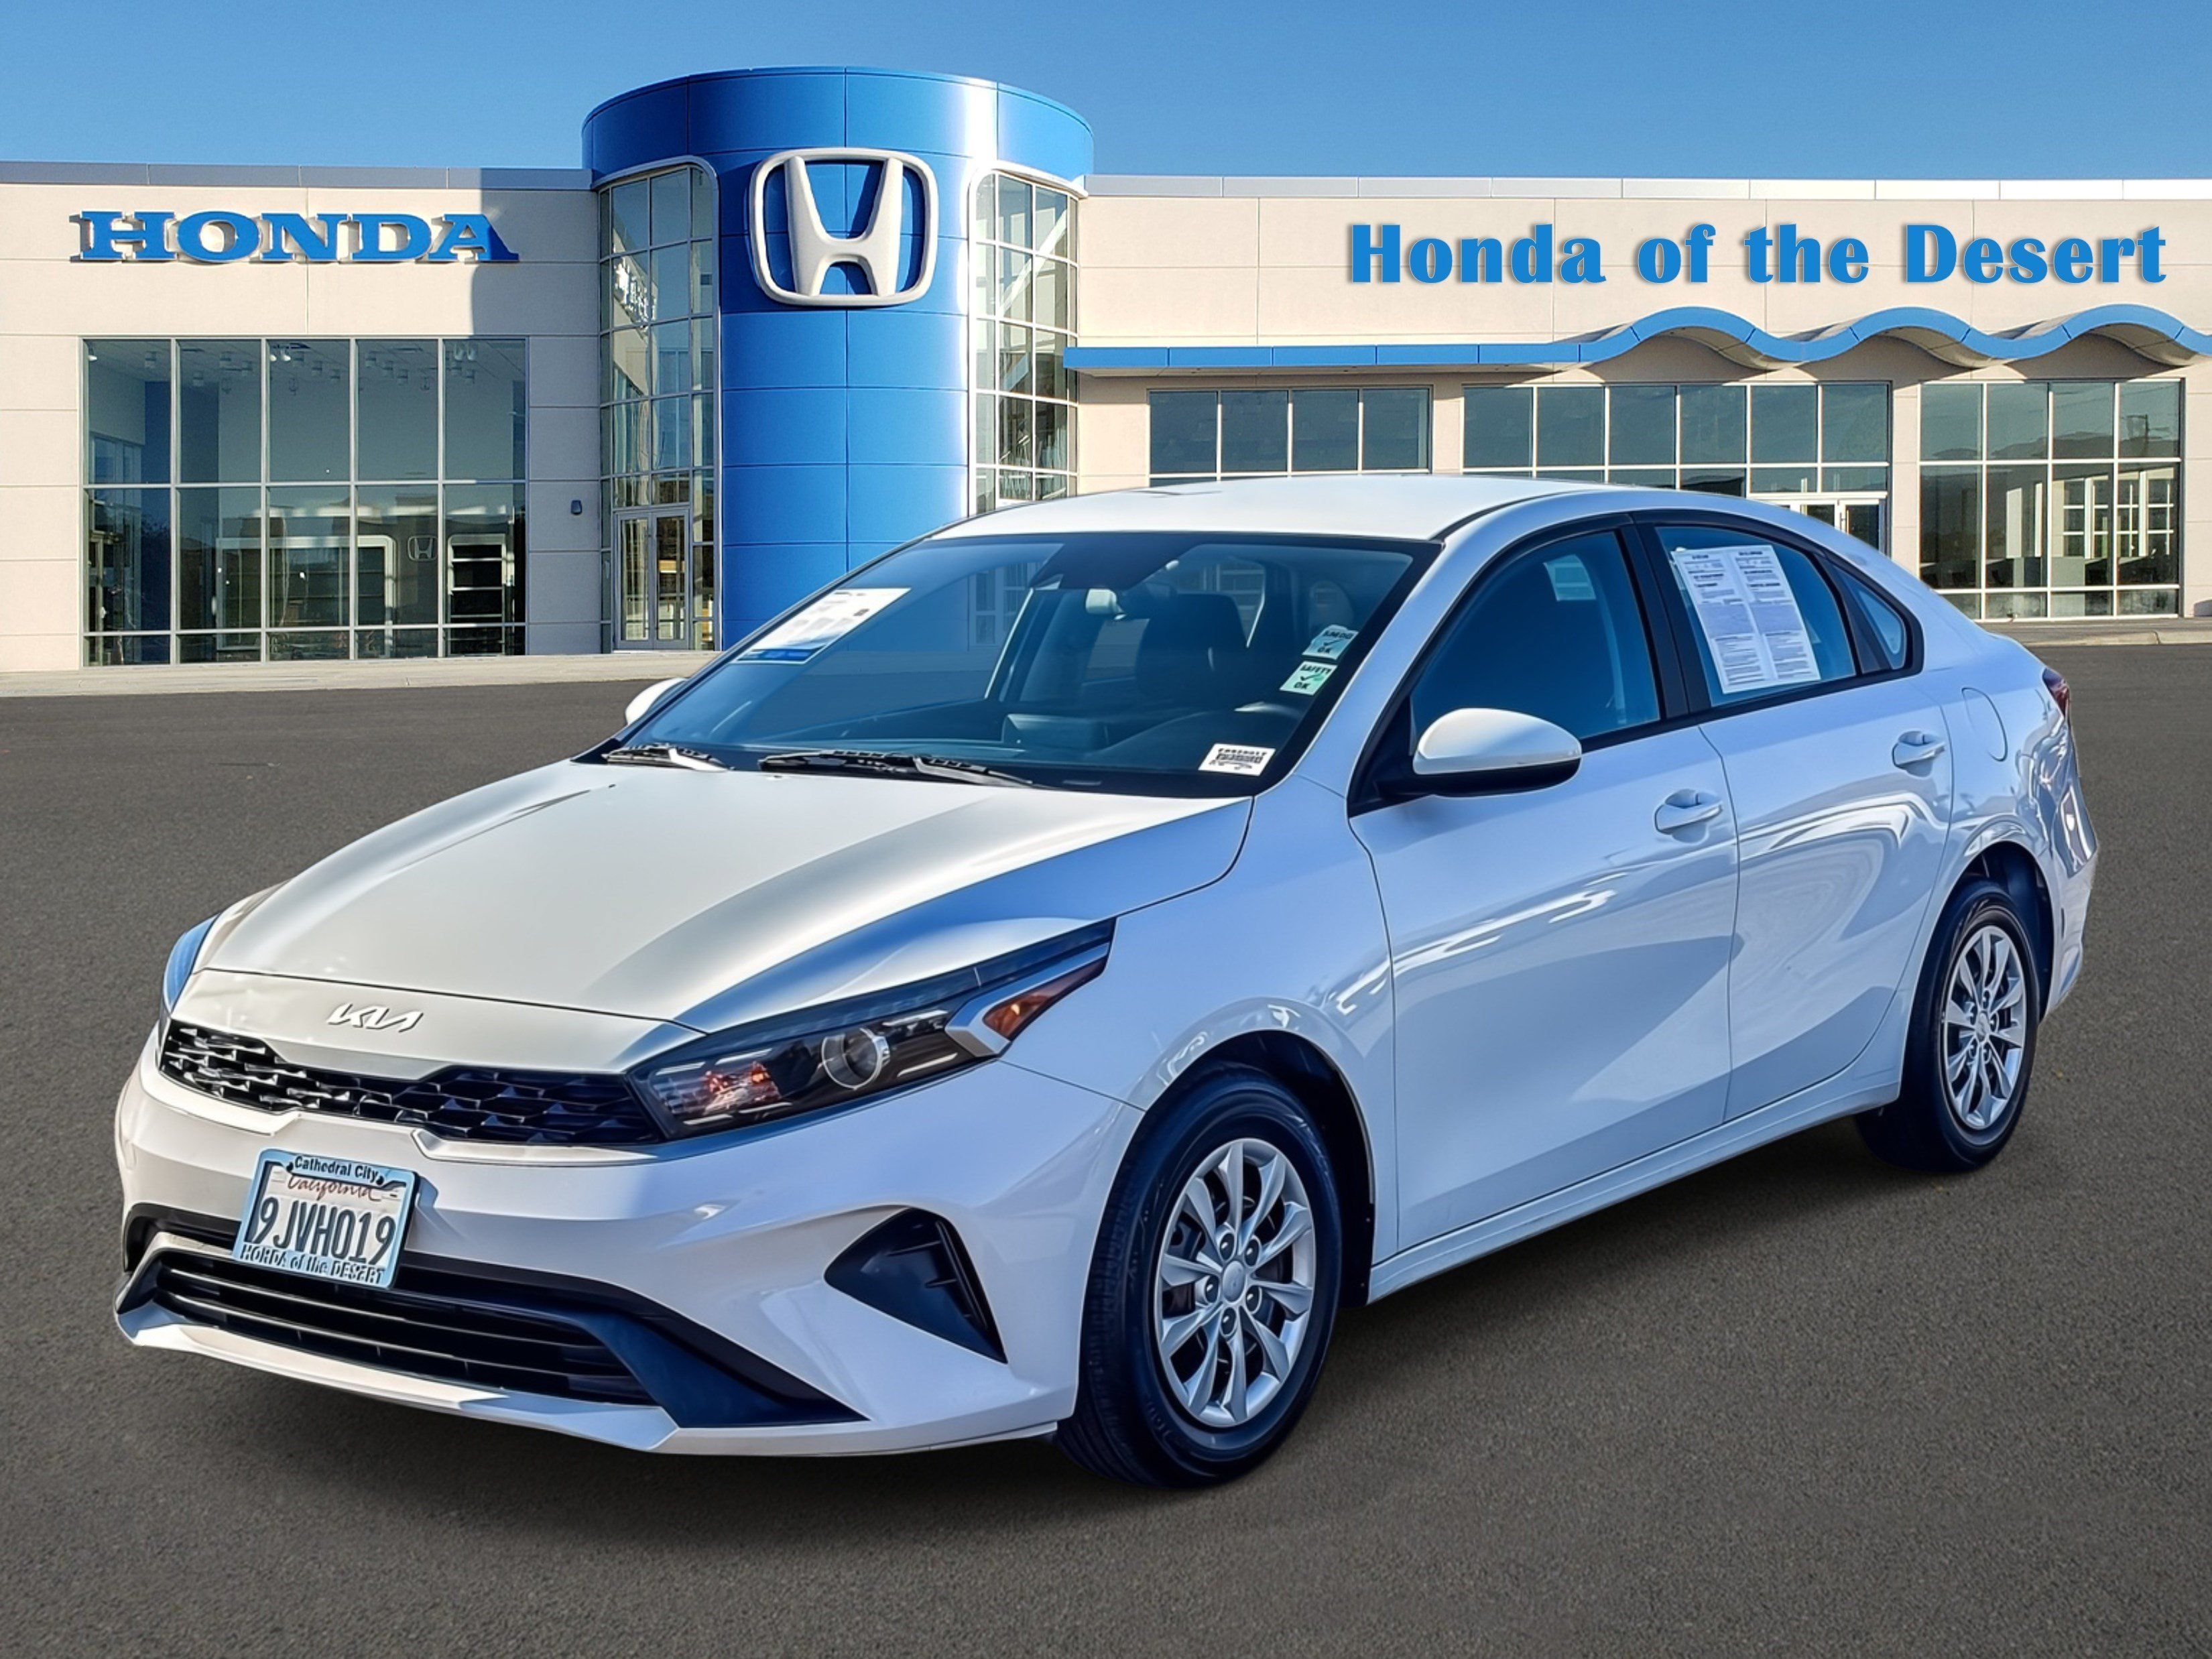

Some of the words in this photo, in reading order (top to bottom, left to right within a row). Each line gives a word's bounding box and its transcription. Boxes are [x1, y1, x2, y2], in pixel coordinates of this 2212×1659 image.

[80, 210, 519, 263] HONDA
[1353, 224, 1607, 284] Honda
[1638, 224, 1717, 284] of
[1744, 224, 1869, 284] the
[1907, 224, 2166, 284] Desert
[294, 1156, 352, 1176] Cathedral
[355, 1165, 378, 1183] City
[252, 1196, 396, 1266] 9JVH019
[290, 1254, 305, 1270] of
[306, 1254, 328, 1274] the
[330, 1260, 386, 1285] DESERT
